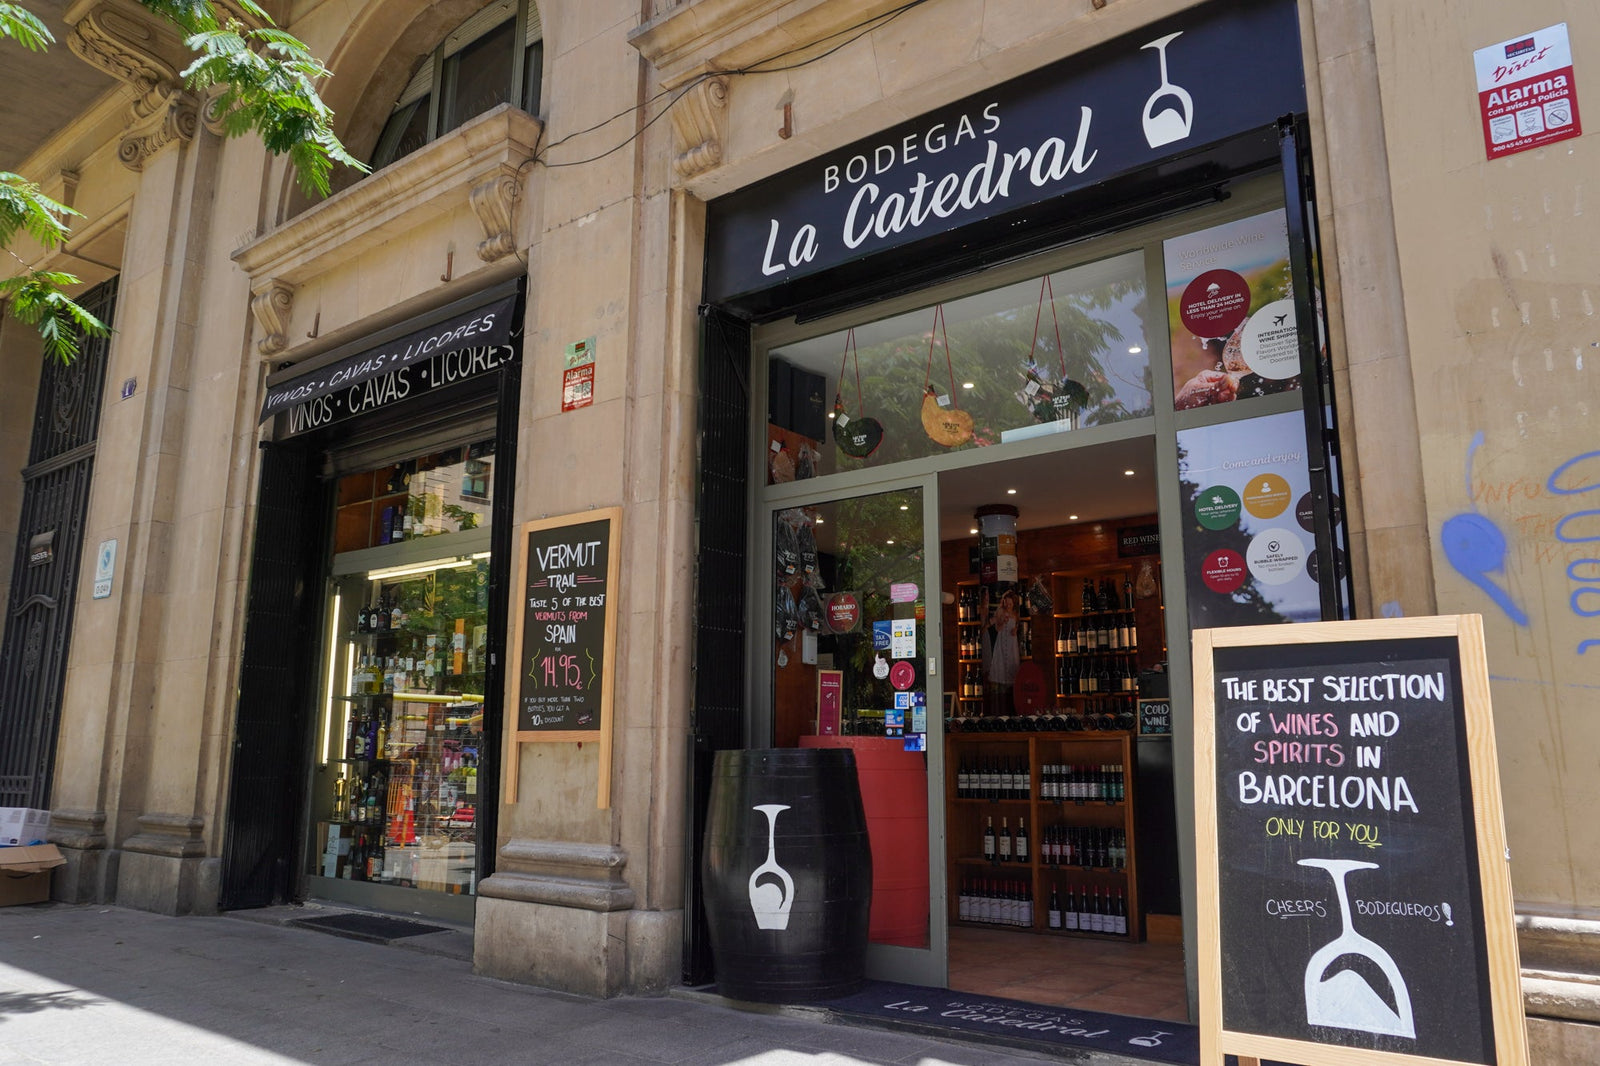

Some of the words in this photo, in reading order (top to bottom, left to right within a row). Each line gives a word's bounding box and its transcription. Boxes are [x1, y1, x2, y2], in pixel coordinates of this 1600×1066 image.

[1492, 45, 1554, 82] Direct
[1487, 75, 1567, 108] Alarma
[1488, 108, 1504, 117] con
[1505, 101, 1529, 112] aviso
[824, 103, 1001, 193] BODEGAS
[761, 219, 819, 276] La
[842, 106, 1098, 249] Catedral
[1207, 295, 1234, 304] DELIVERY
[1224, 297, 1244, 306] HOURS
[267, 382, 316, 409] VINOS
[329, 354, 386, 387] CAVAS
[403, 313, 495, 361] LICORES
[290, 394, 334, 434] VINOS
[348, 367, 411, 413] CAVAS
[430, 344, 514, 388] LICORES
[1222, 460, 1250, 470] Come
[1251, 455, 1271, 466] and
[1272, 453, 1301, 466] enjoy
[1123, 537, 1138, 545] RED
[536, 541, 601, 572] VERMUT
[547, 573, 577, 594] TRAIL
[529, 598, 548, 609] TASTE
[551, 597, 558, 610] 5
[562, 596, 570, 607] OF
[575, 596, 587, 606] THE
[589, 594, 605, 607] BEST
[534, 612, 566, 622] VERMUTS
[568, 612, 588, 622] FROM
[544, 624, 576, 644] SPAIN
[1221, 678, 1258, 703] THE
[1263, 678, 1315, 704] BEST
[1322, 672, 1445, 703] SELECTION
[1144, 704, 1170, 715] COLD
[1144, 716, 1169, 726] WINE
[1236, 712, 1260, 734] OF
[1269, 712, 1340, 738] WINES
[1349, 710, 1400, 738] AND
[1253, 741, 1346, 768] SPIRITS
[1356, 746, 1381, 770] IN
[1238, 771, 1419, 814] BARCELONA
[1265, 816, 1305, 840] ONLY
[1312, 820, 1340, 841] FOR
[1345, 822, 1379, 845] YOU
[1265, 898, 1326, 917] CHEERS
[1356, 899, 1454, 928] BODEGUEROS!
[883, 1000, 928, 1012] La
